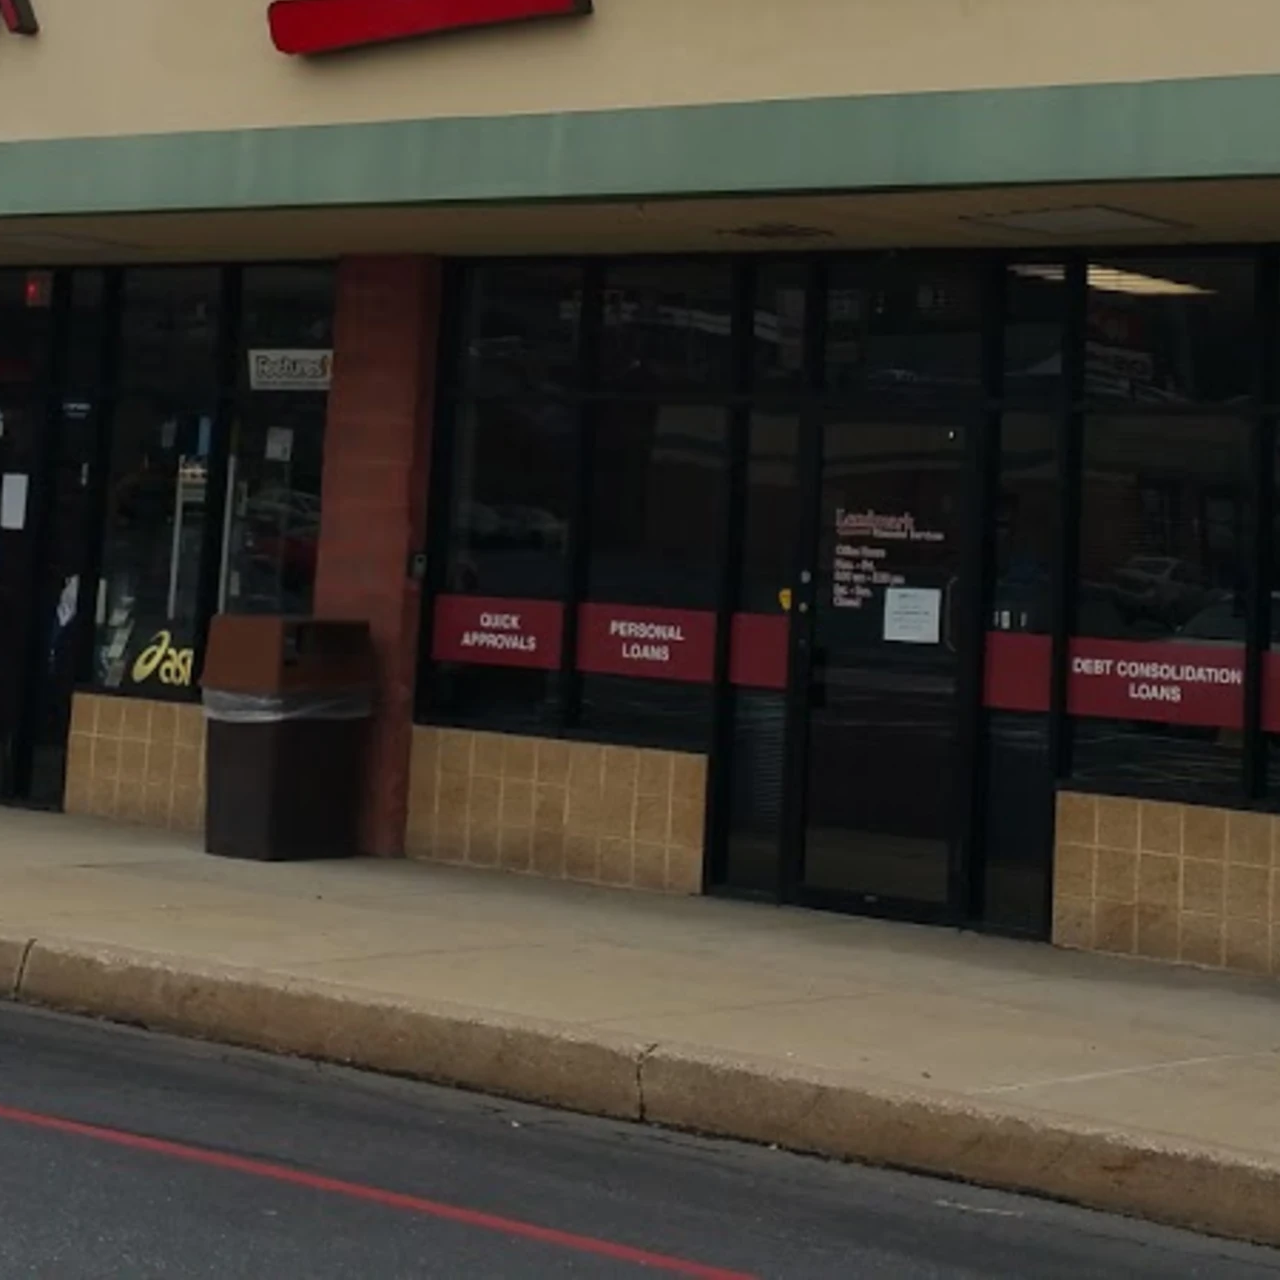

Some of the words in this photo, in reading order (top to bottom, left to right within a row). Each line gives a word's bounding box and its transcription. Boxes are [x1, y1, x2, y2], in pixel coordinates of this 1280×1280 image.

[479, 612, 522, 630] QUICK
[609, 619, 686, 642] PERSONAL
[461, 630, 537, 651] APPROVALS
[622, 642, 670, 662] LOANS
[1071, 656, 1114, 675] DEBT
[1116, 660, 1243, 685] CONSOLIDATION
[1128, 682, 1182, 703] LOANS
